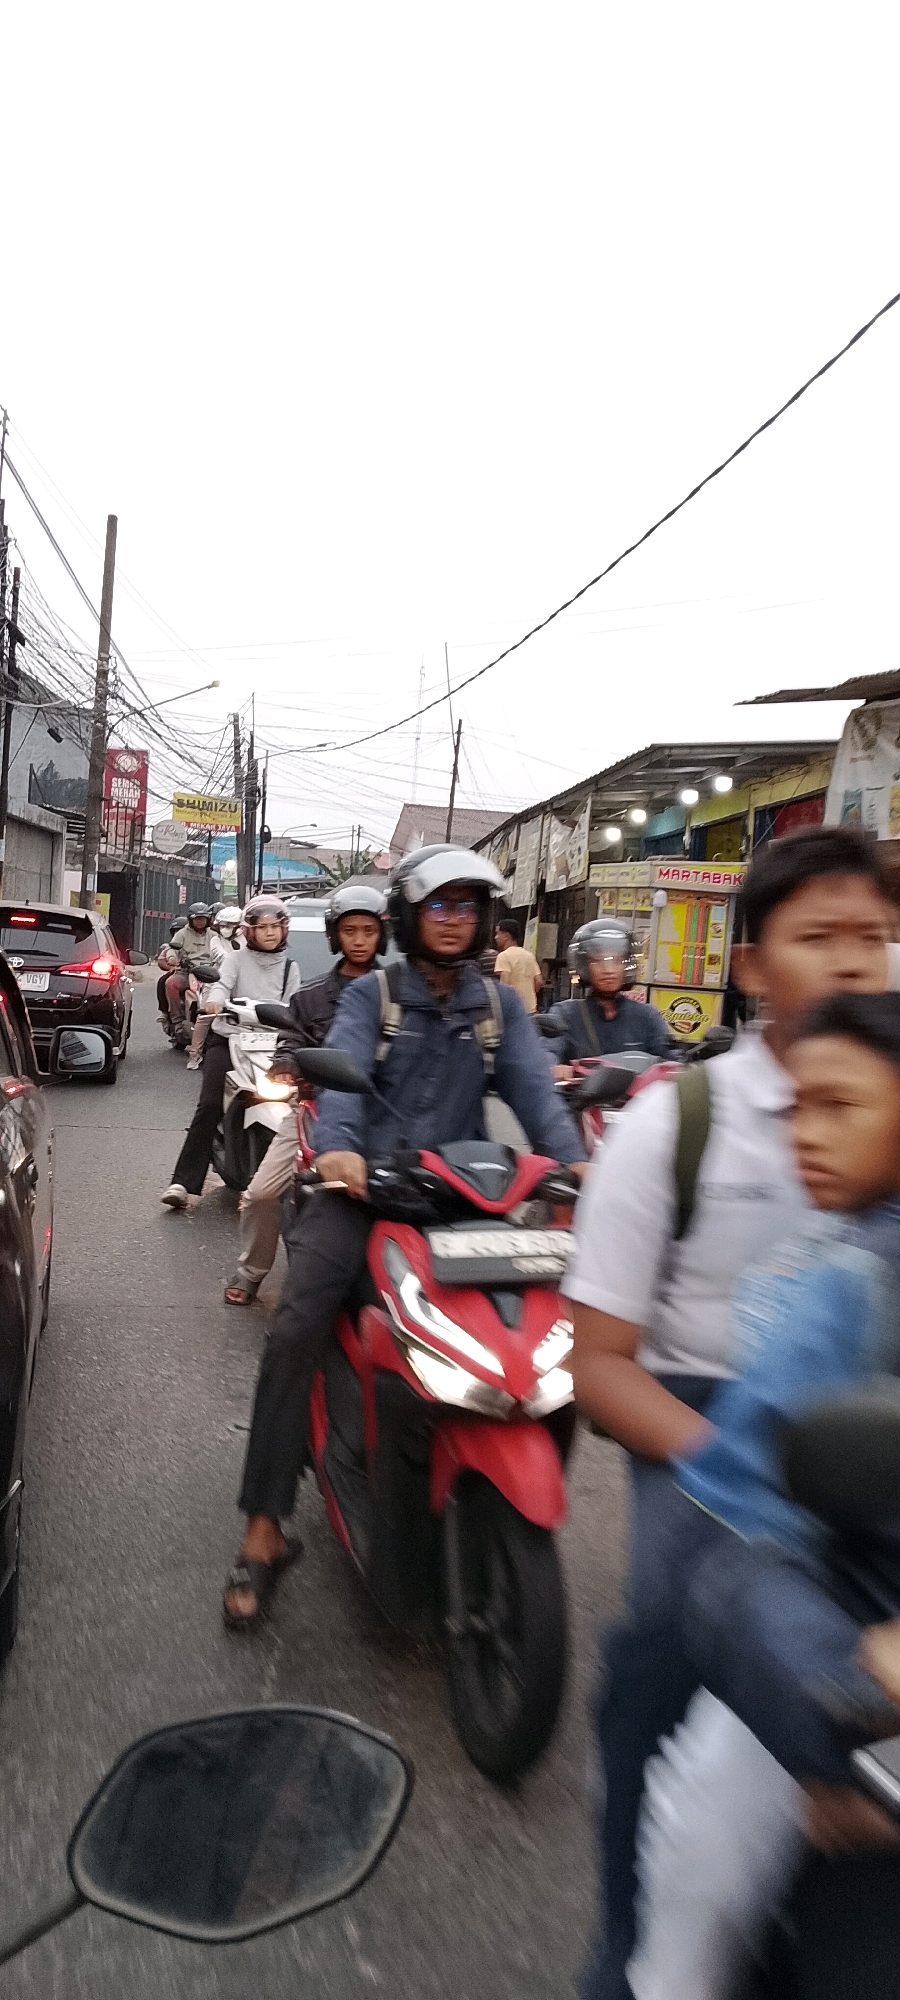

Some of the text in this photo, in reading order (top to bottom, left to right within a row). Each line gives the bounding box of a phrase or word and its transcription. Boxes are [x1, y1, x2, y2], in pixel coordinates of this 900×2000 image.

[111, 777, 141, 789] SEMEN
[110, 787, 141, 799] MERAH
[111, 797, 139, 808] PUTIH
[176, 798, 239, 814] SHIMIZU
[217, 824, 236, 832] JAYA
[658, 865, 745, 887] MARTABAK
[26, 974, 44, 984] VGY
